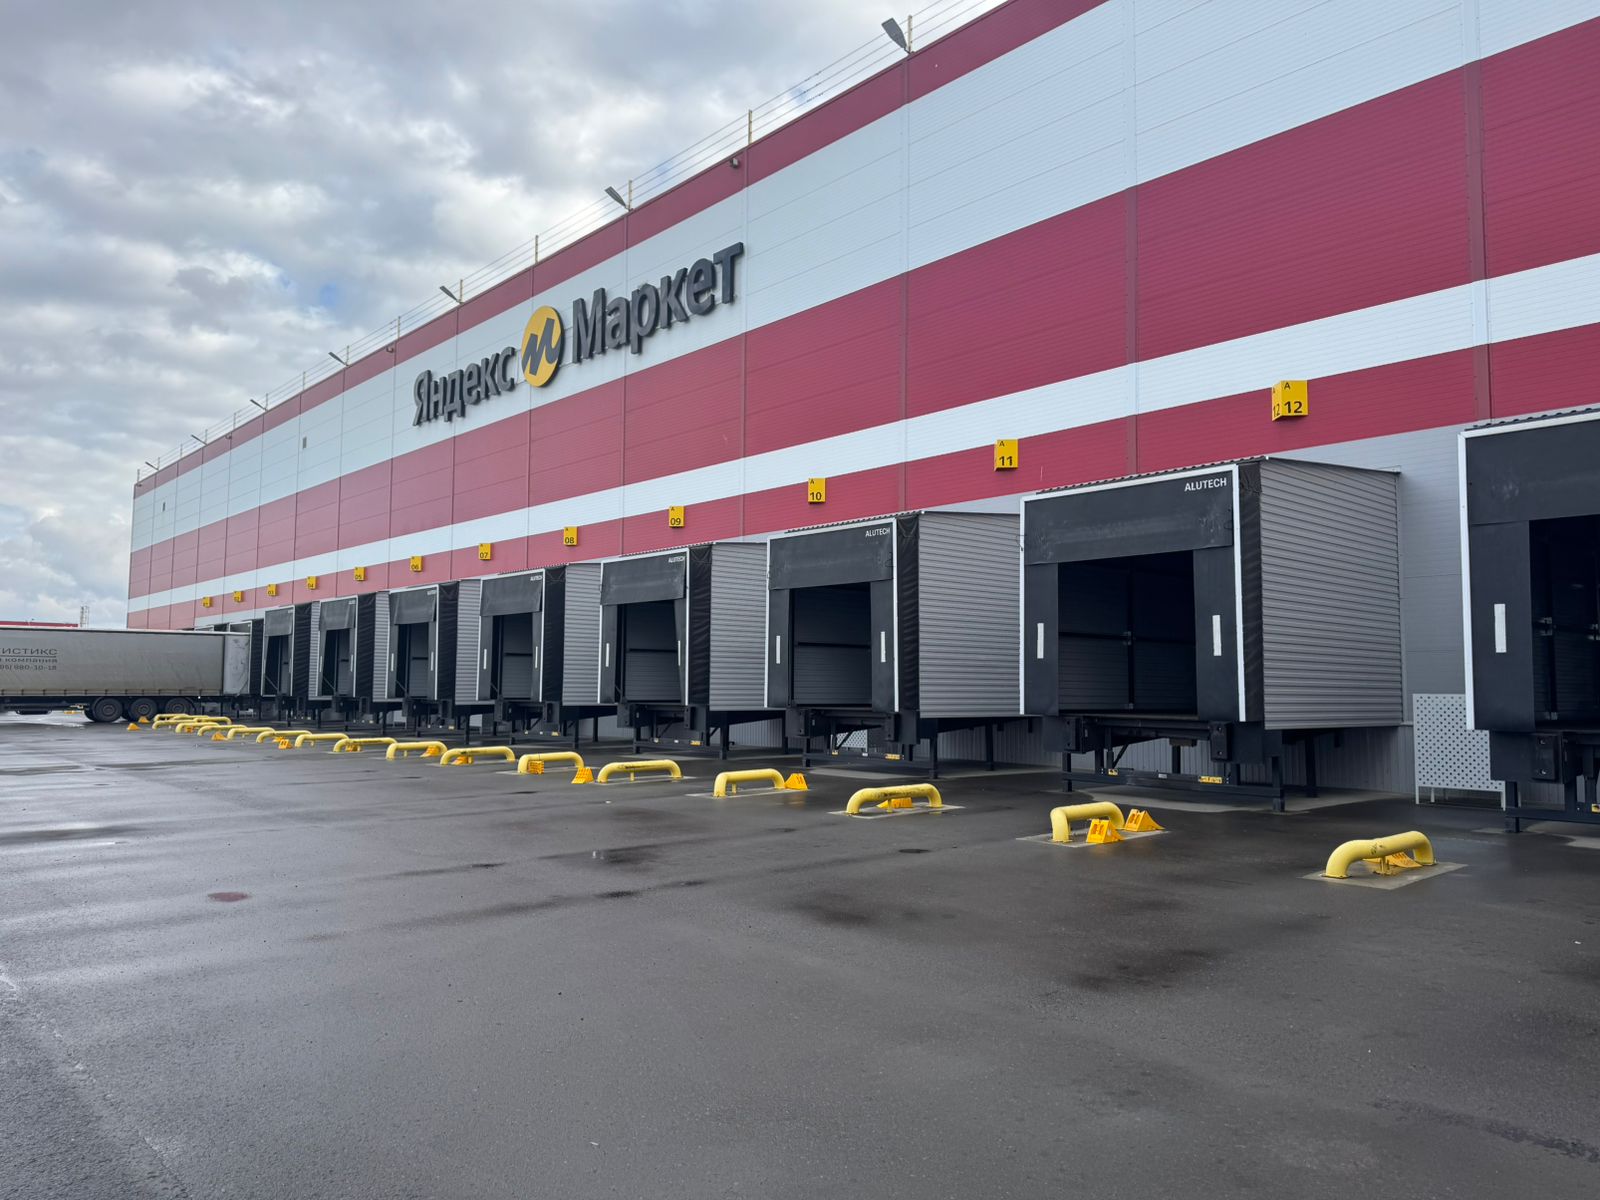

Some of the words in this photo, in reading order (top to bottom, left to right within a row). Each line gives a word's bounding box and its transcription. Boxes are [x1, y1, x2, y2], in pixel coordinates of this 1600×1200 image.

[413, 346, 516, 426] Яндекс
[572, 242, 744, 364] Маркет
[1284, 401, 1303, 414] 12
[999, 455, 1013, 467] 11
[1184, 477, 1227, 492] ALUTECH
[810, 491, 822, 500] 10
[670, 518, 681, 526] 09
